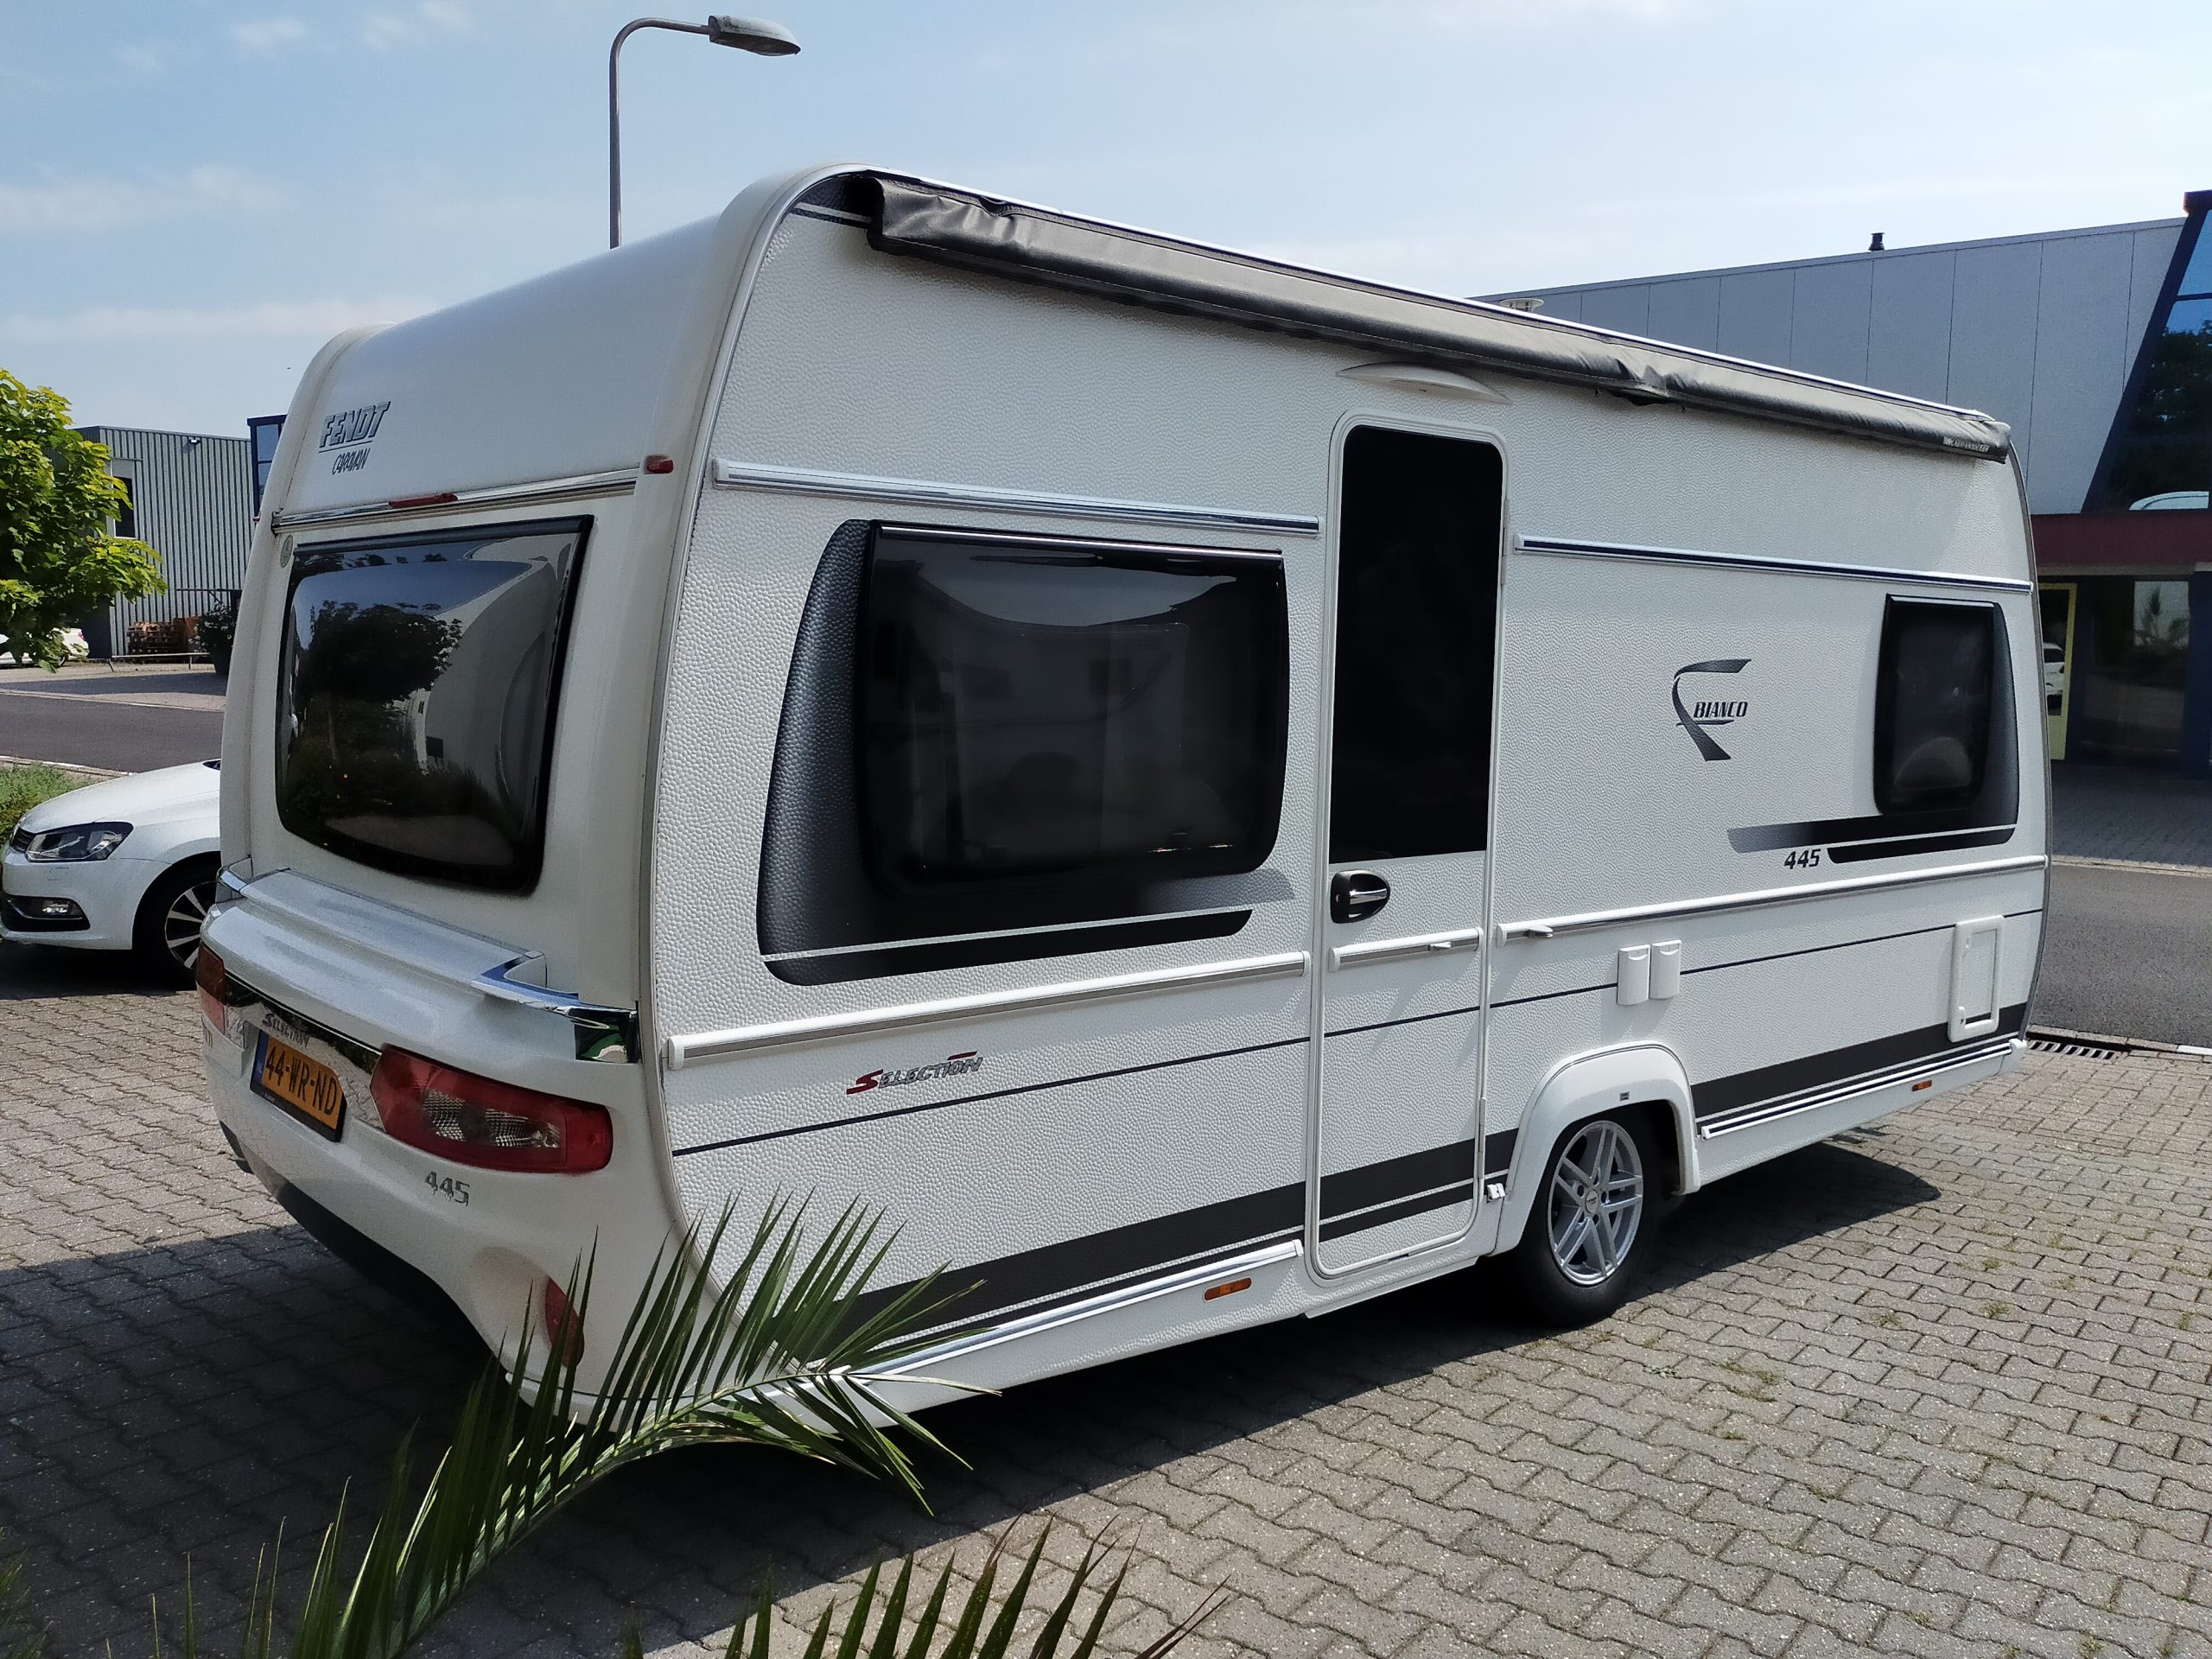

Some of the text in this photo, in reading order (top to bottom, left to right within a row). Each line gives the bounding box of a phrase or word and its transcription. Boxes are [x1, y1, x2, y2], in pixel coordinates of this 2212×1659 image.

[319, 401, 391, 448] FENDT
[1693, 701, 1748, 718] BIANCO
[1783, 849, 1821, 869] 445
[265, 1046, 338, 1115] 44-WR-ND
[846, 1052, 983, 1095] SELECTION
[424, 1171, 470, 1207] 445
